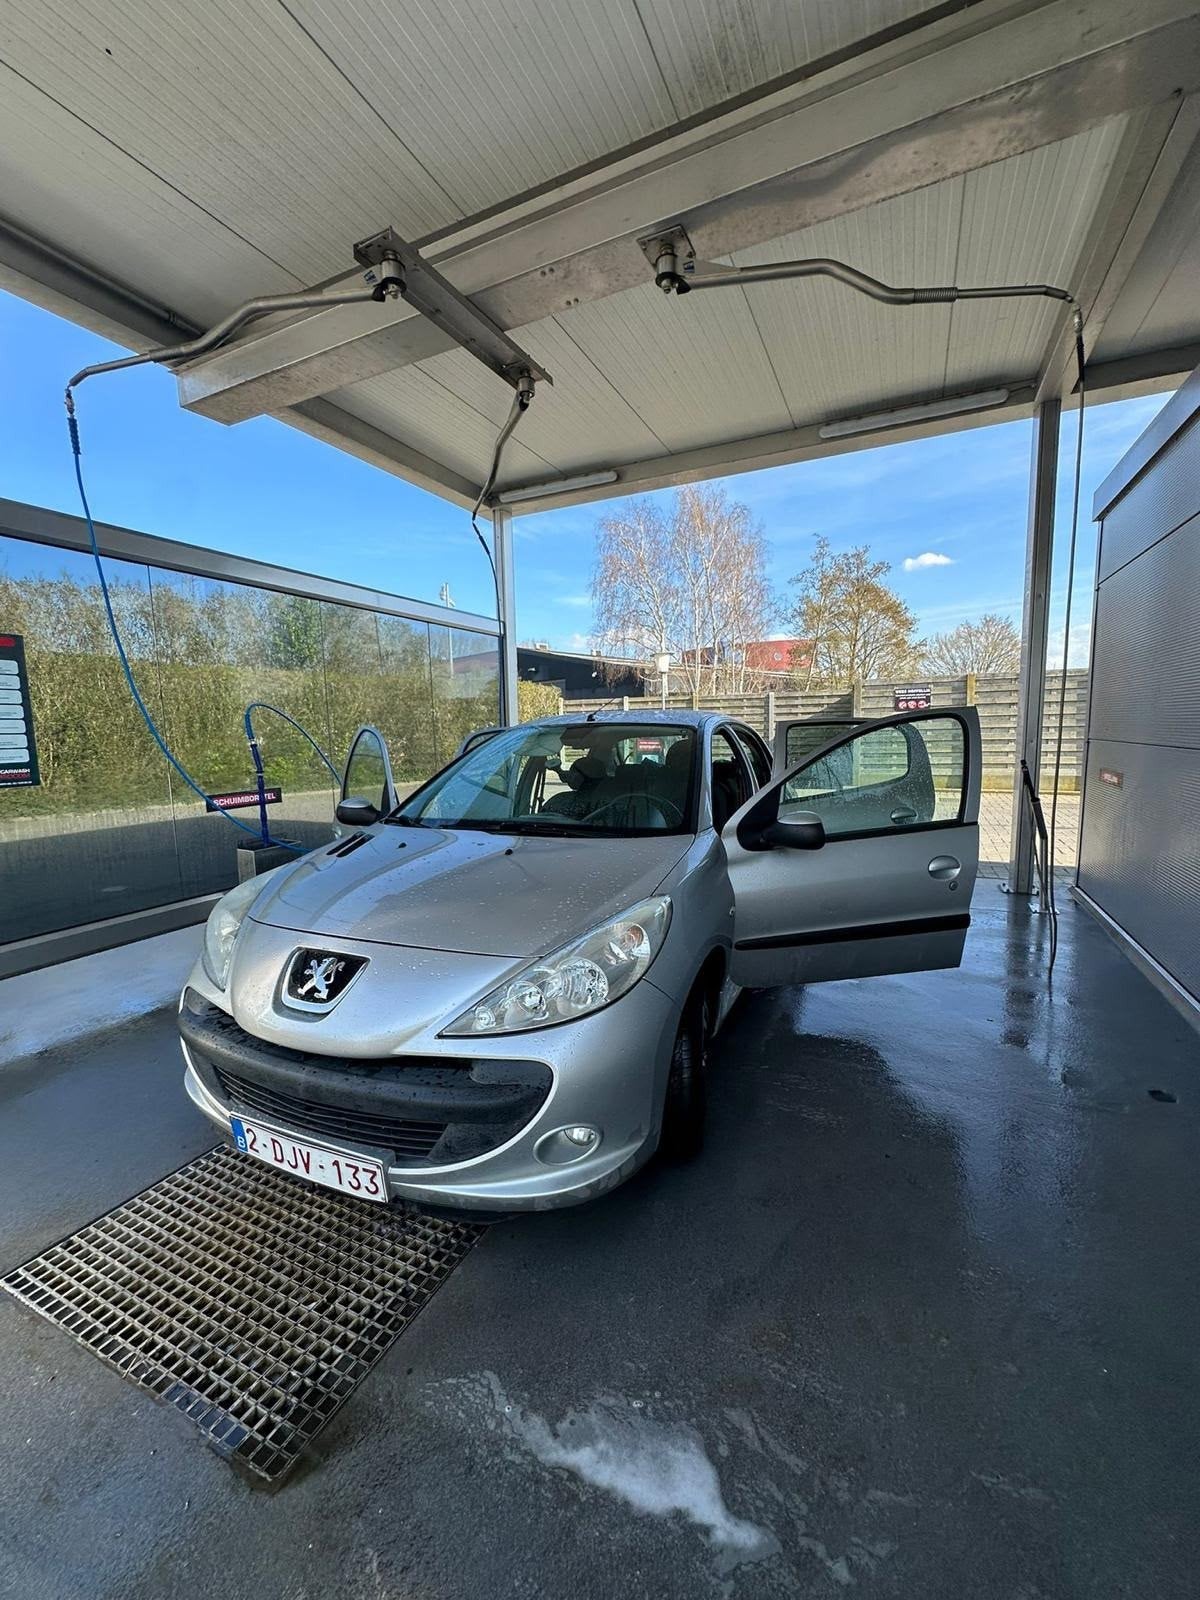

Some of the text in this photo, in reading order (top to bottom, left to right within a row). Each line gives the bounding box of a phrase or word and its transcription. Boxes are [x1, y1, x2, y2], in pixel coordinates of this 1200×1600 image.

[213, 793, 276, 806] SCHUIMBORTEL
[237, 1136, 246, 1148] B
[245, 1127, 380, 1195] 2-DJV-133
